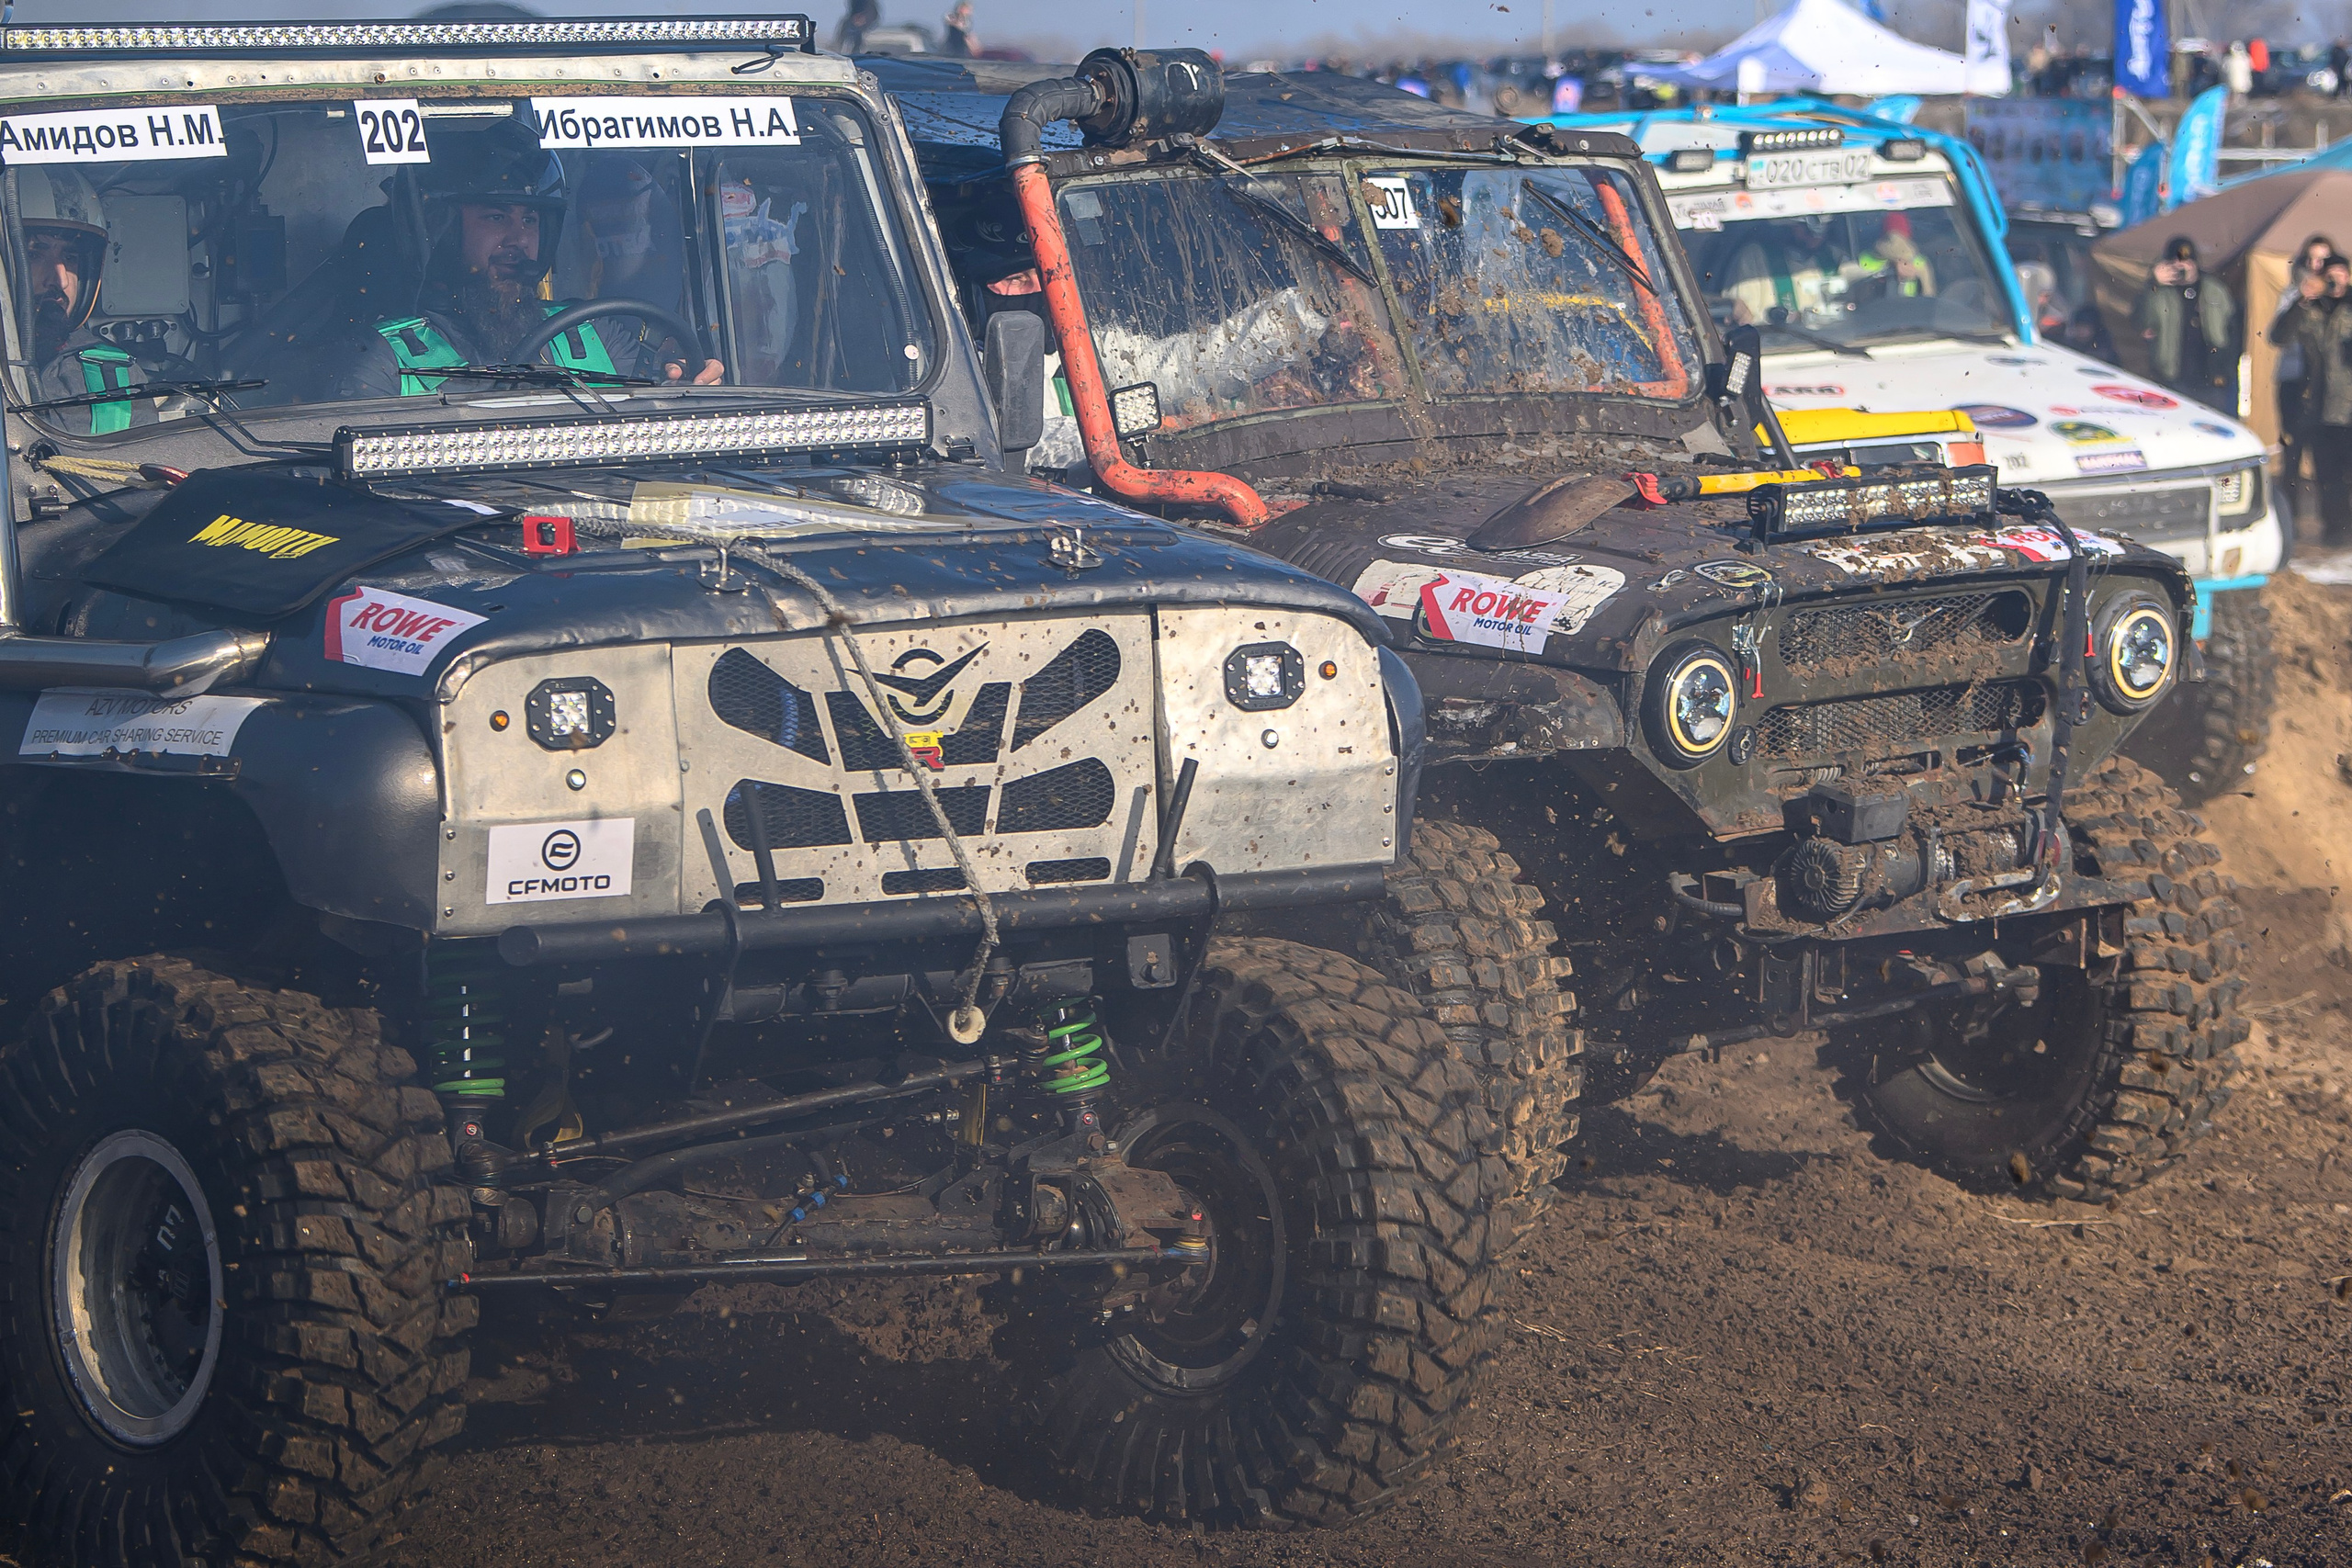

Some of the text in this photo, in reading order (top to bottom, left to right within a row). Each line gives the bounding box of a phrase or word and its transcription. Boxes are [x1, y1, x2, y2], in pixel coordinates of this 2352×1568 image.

[361, 108, 426, 153] 202
[536, 107, 722, 146] Ибрагимов
[1449, 586, 1550, 624] ROWE
[348, 602, 457, 642] ROWE
[1473, 617, 1532, 637] MOTOR OIL
[367, 635, 424, 655] MOTOR OIL
[85, 698, 192, 716] AZV MOTORS
[31, 728, 224, 746] PREMIUM CAR SHARING SERVICE
[507, 874, 611, 896] CFMOTO
